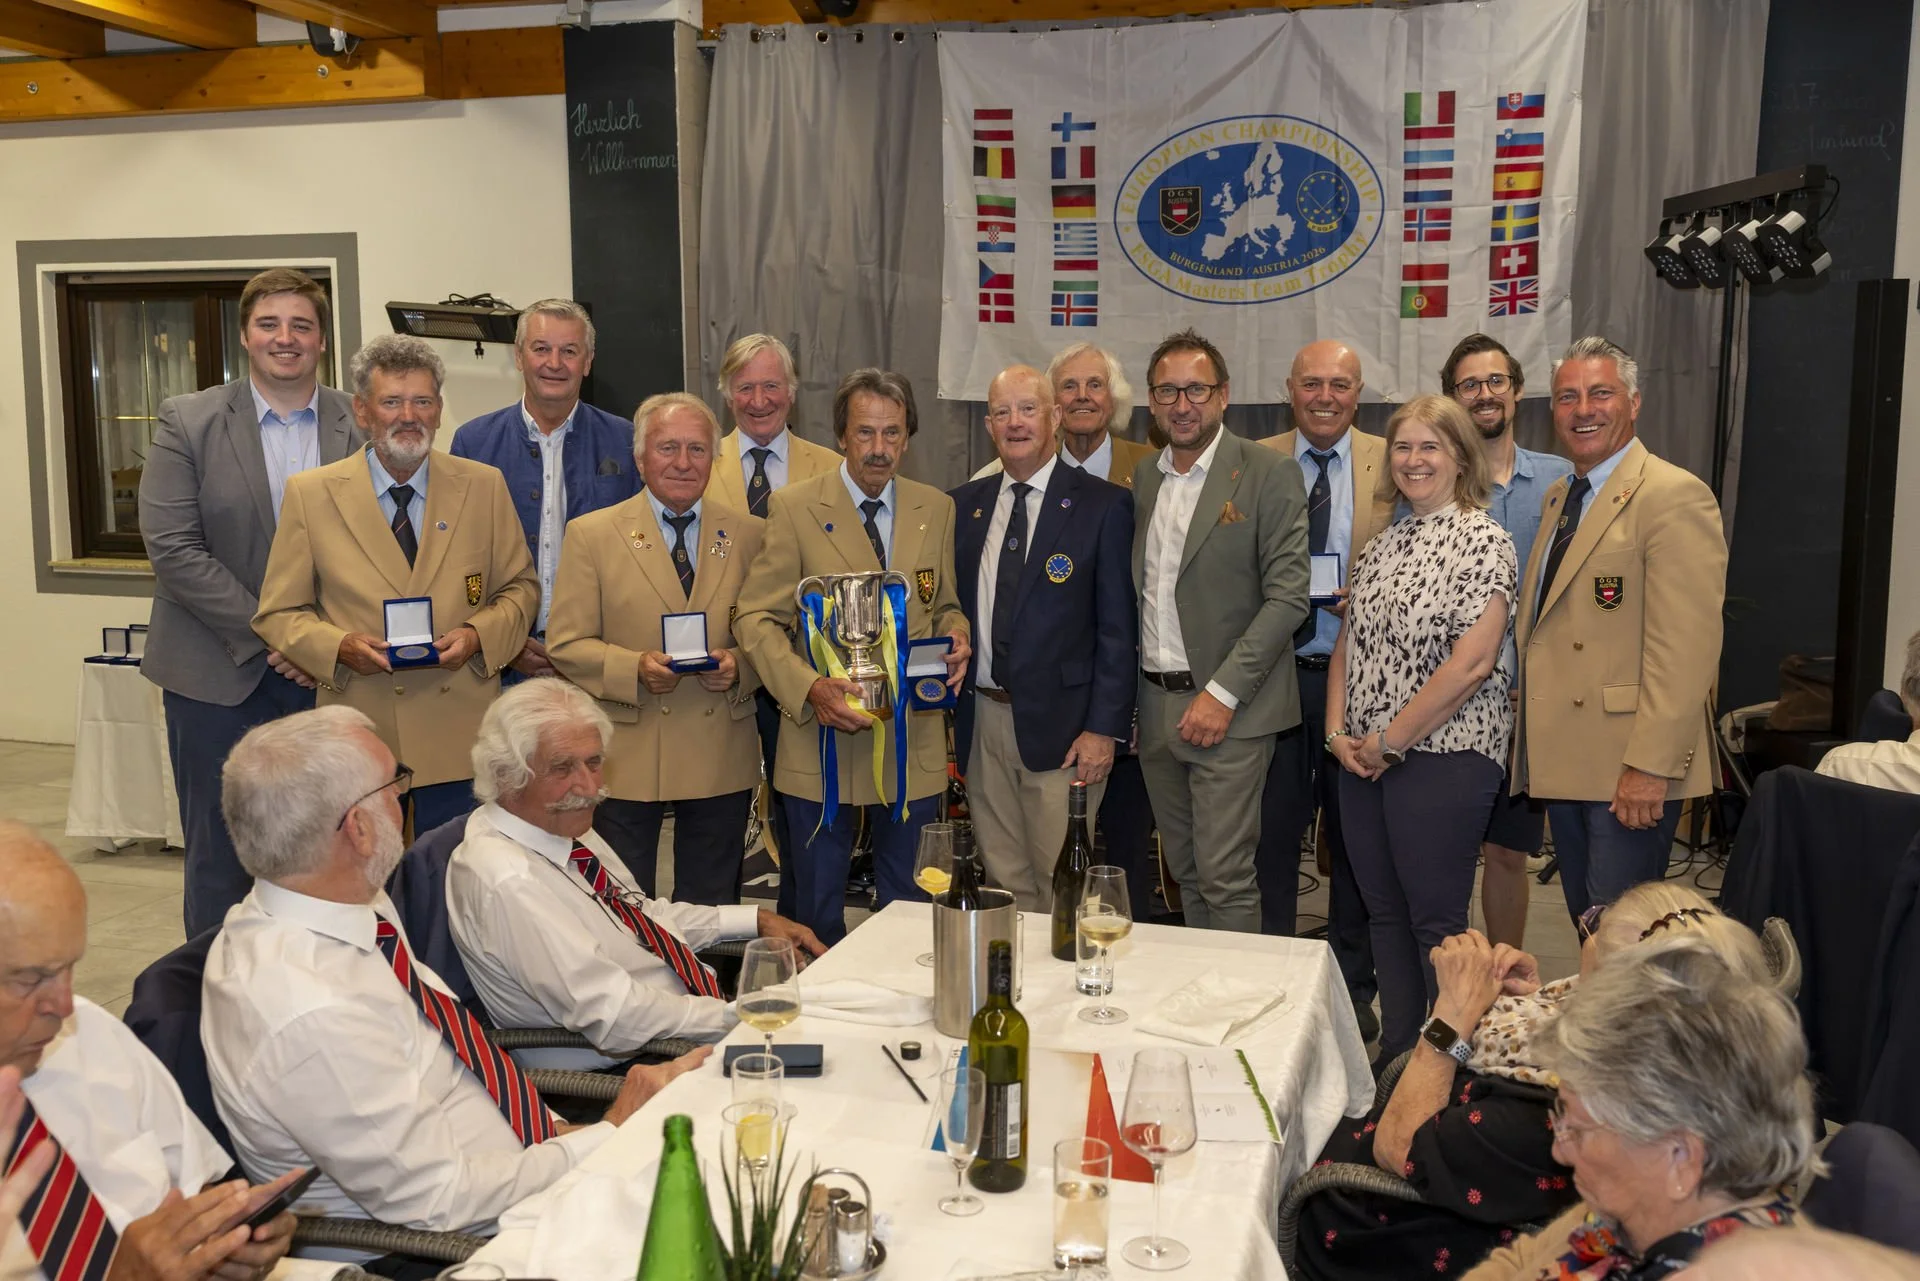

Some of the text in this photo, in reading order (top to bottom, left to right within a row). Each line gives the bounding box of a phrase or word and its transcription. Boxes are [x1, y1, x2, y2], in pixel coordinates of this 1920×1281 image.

[570, 98, 642, 136] Herzlich
[581, 141, 677, 175] Willkommen
[1120, 120, 1379, 215] EUROPEAN CHAMPIONSHIP
[1167, 197, 1193, 205] AUSTRIA
[1130, 231, 1369, 300] ESGA Masters Team Trophy
[1169, 251, 1243, 277] BURGENLAND
[1252, 258, 1300, 276] AUSTRIA
[1301, 246, 1327, 264] 2026
